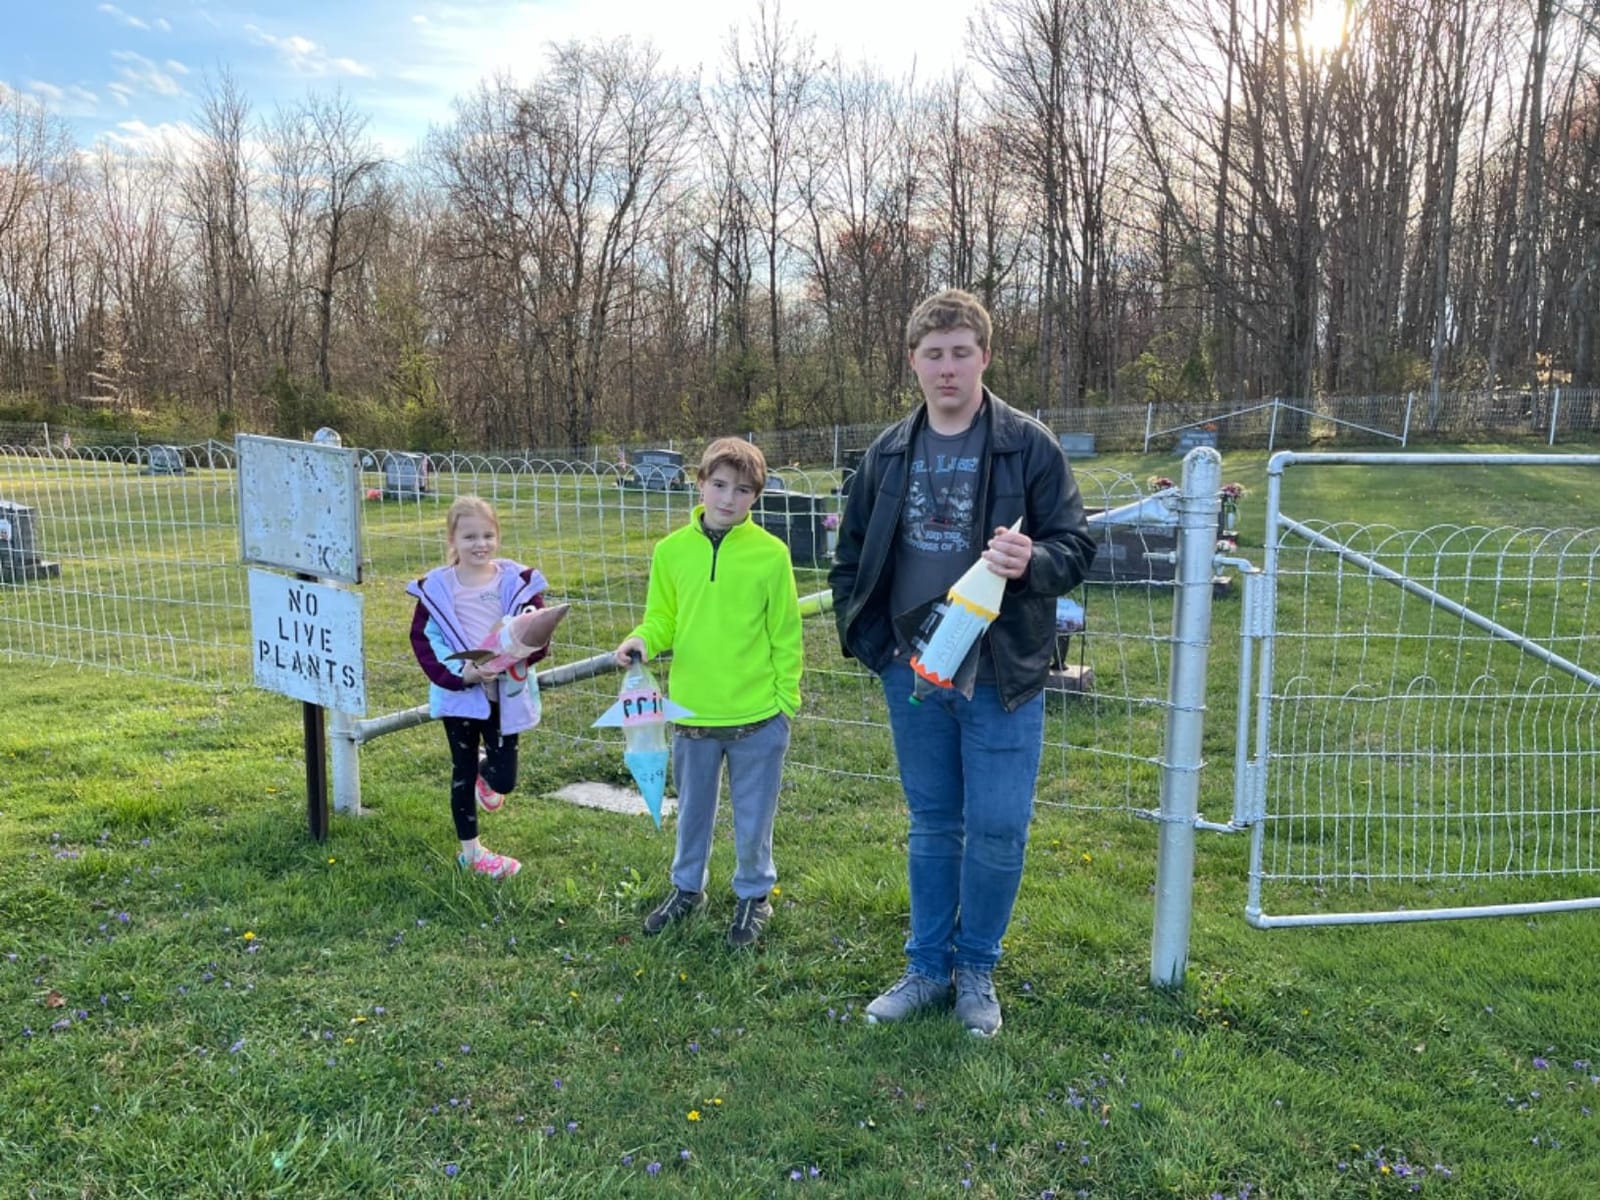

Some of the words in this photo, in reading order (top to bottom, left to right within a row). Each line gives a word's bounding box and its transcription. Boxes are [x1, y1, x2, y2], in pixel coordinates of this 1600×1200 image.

[288, 588, 318, 617] NO
[278, 616, 333, 654] LIVE
[259, 640, 356, 689] PLANTS
